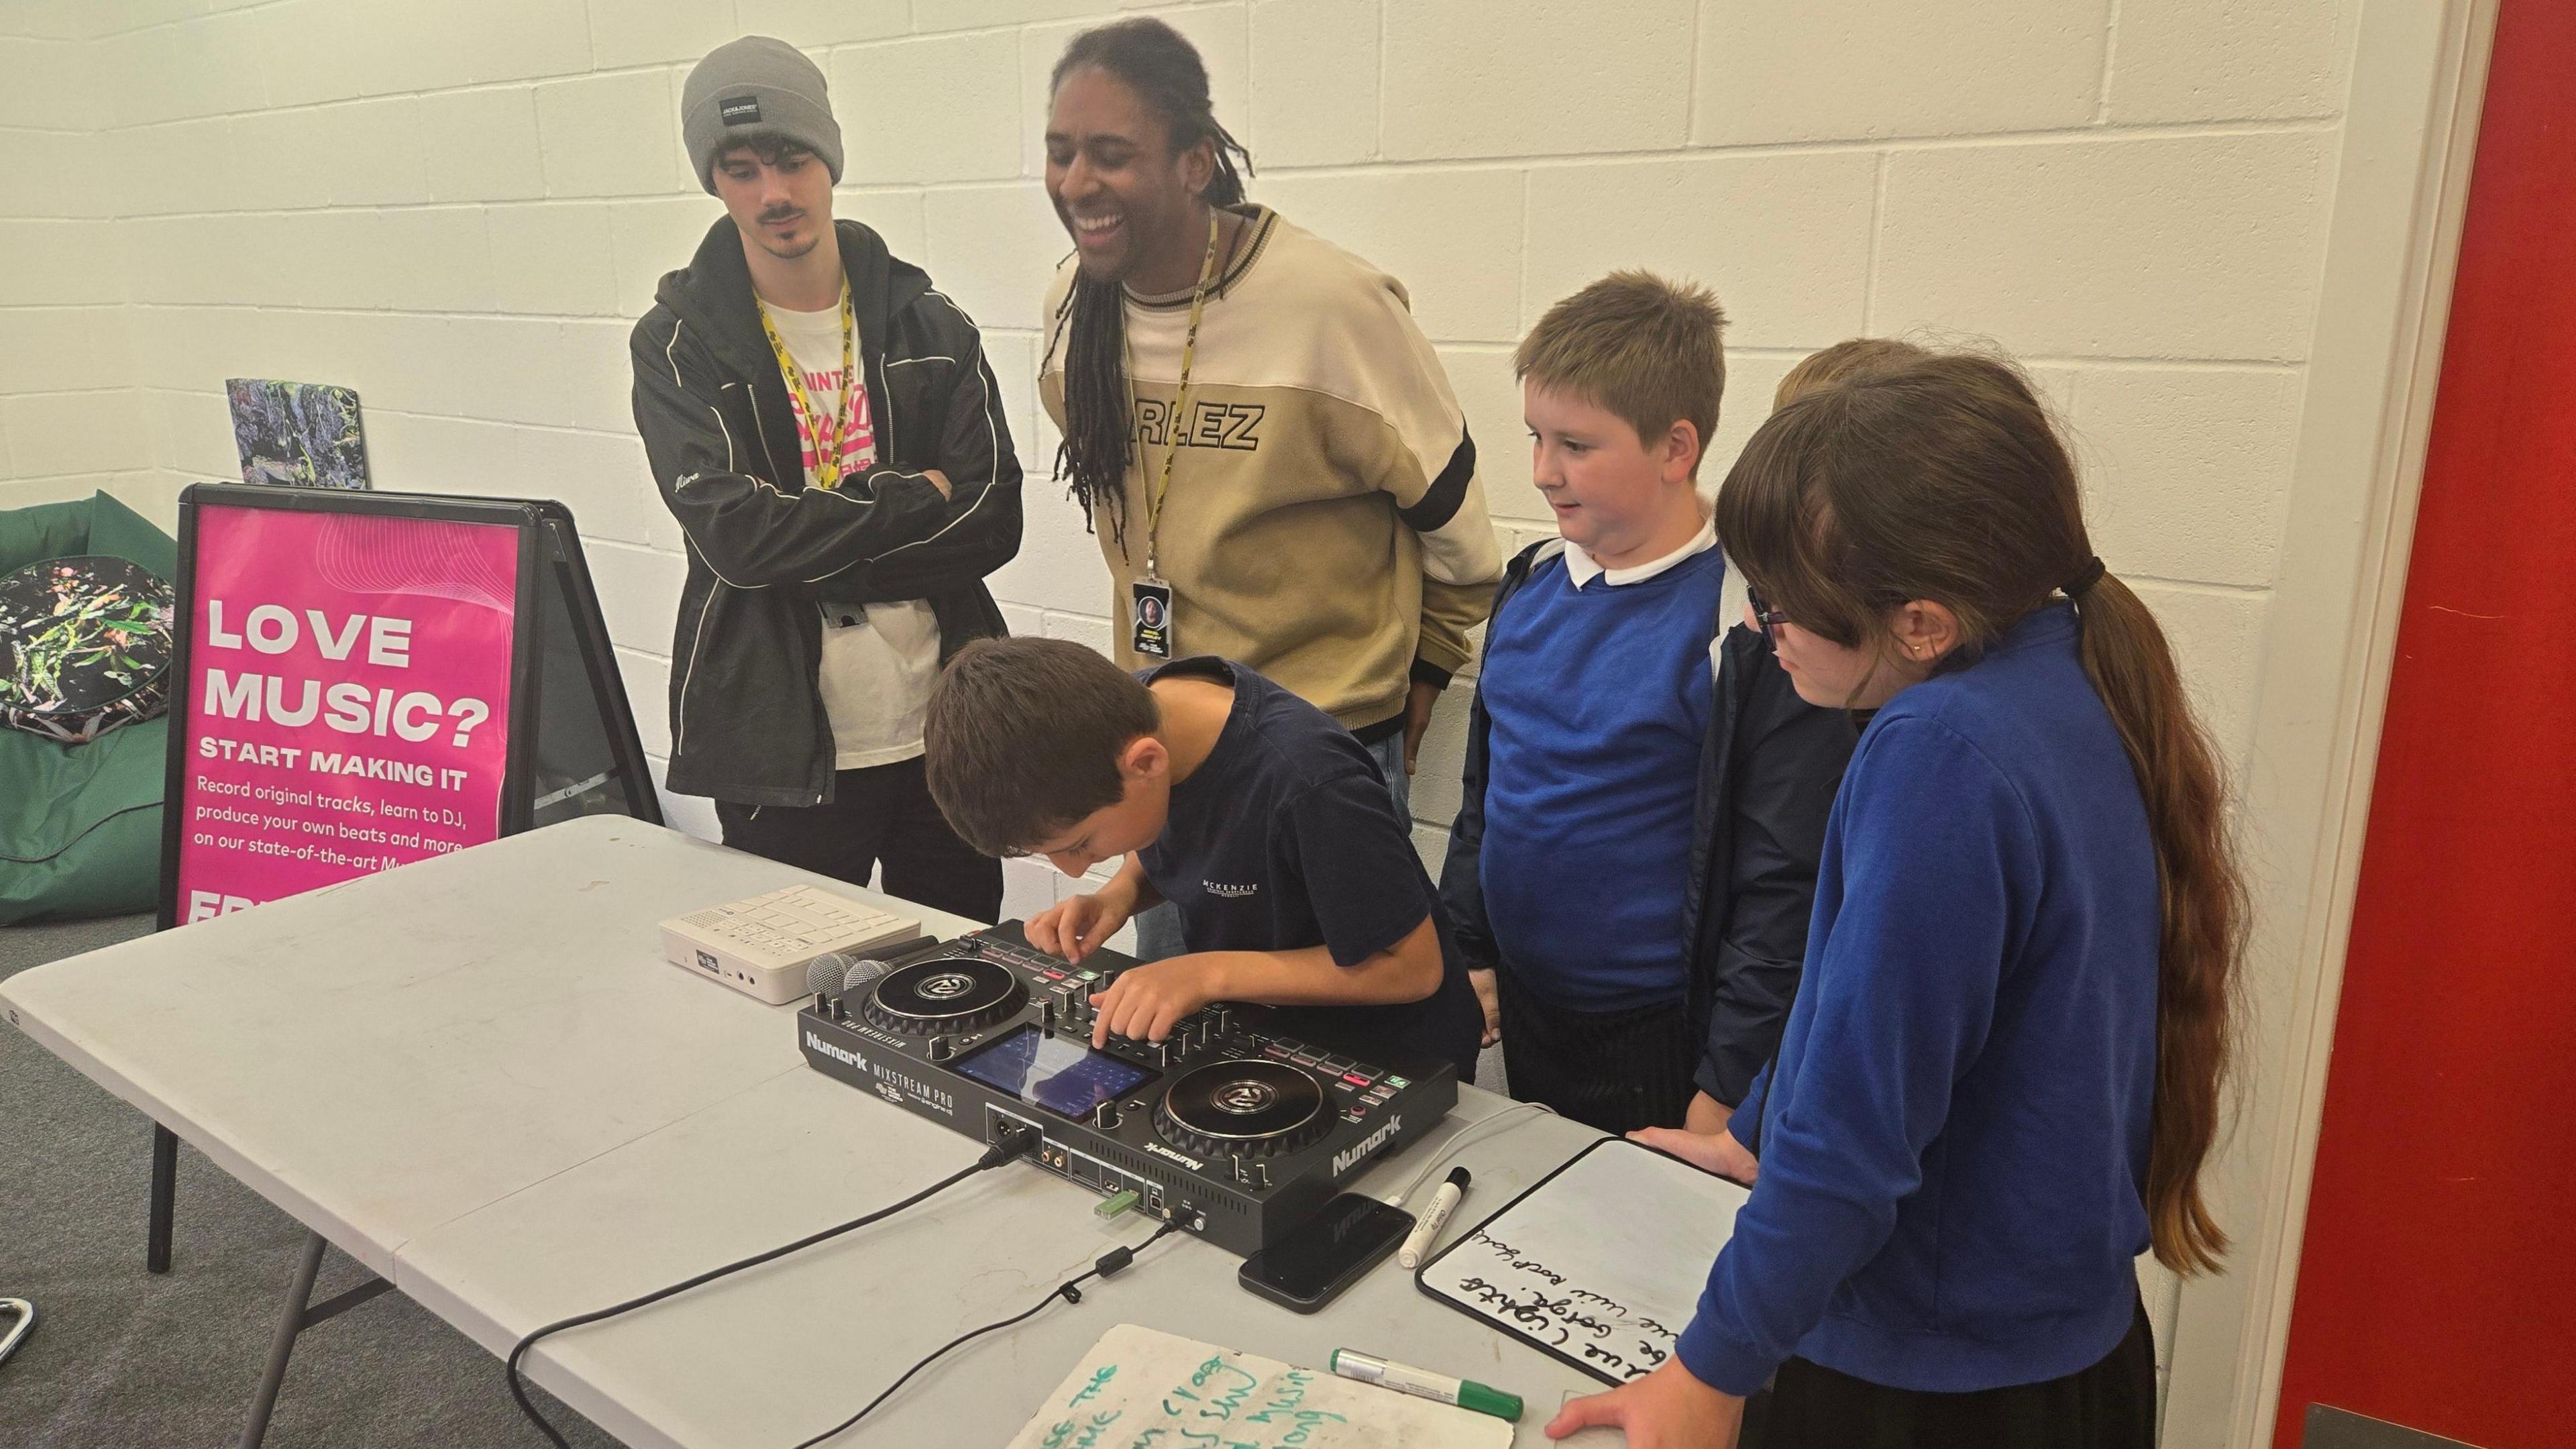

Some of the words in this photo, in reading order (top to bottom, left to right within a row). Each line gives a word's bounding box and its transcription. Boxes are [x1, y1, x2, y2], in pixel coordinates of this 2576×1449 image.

[209, 599, 413, 668] LOVE
[204, 668, 489, 748] MUSIC?
[199, 737, 301, 769] START
[310, 753, 433, 787] MAKING
[441, 768, 468, 792] IT
[197, 775, 250, 797] Record
[255, 786, 312, 806] original
[317, 794, 375, 816] tracks,
[380, 799, 418, 820] learn
[422, 807, 439, 822] to
[443, 808, 466, 830] DJ,
[194, 833, 213, 845] on
[218, 836, 245, 849] our
[248, 839, 377, 870] state-of-the-art
[196, 805, 259, 825] produce
[263, 815, 298, 830] your
[302, 821, 334, 836] own
[339, 822, 386, 843] beats
[390, 832, 419, 848] and
[423, 838, 462, 853] more
[806, 1030, 867, 1072] Numark
[873, 1063, 930, 1098] MIXSTREAM
[934, 1088, 953, 1108] PRO
[1143, 1142, 1204, 1171] Numark
[1333, 1114, 1401, 1177] Numark
